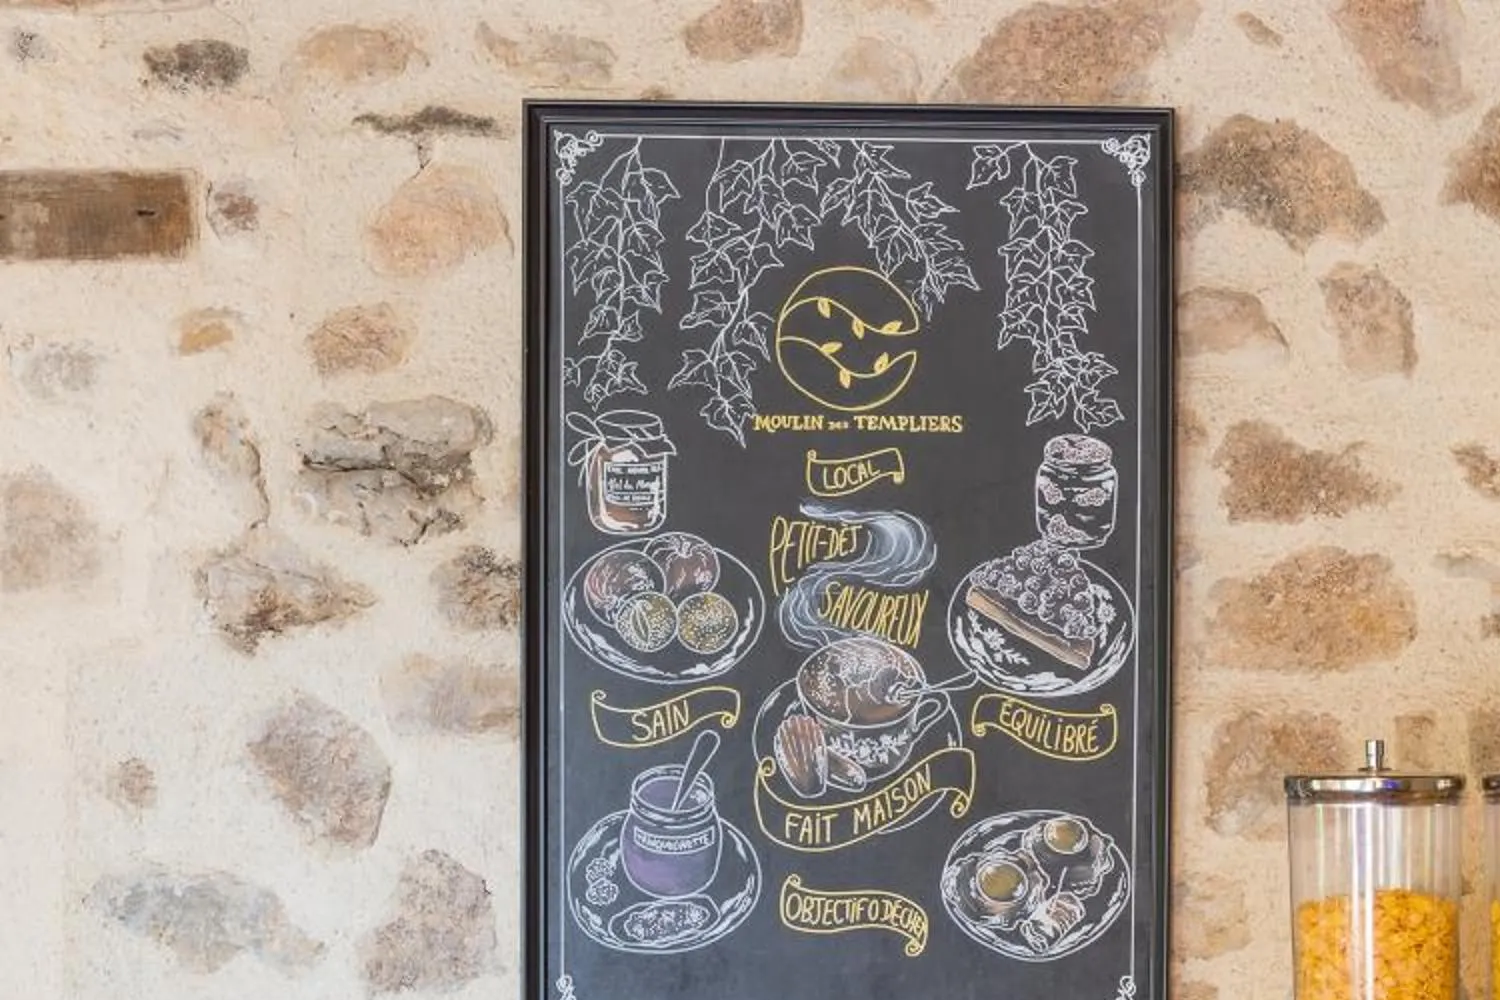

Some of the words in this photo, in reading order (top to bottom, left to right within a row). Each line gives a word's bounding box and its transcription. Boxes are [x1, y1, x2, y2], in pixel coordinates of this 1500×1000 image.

[754, 415, 825, 433] MOULIN
[853, 414, 963, 433] TEMPLIERS
[822, 460, 881, 490] LOCAL
[817, 581, 929, 649] SAVOUREUX
[631, 699, 690, 742] SAIN
[853, 763, 932, 835] MAISON
[785, 892, 868, 926] OBJECTIF
